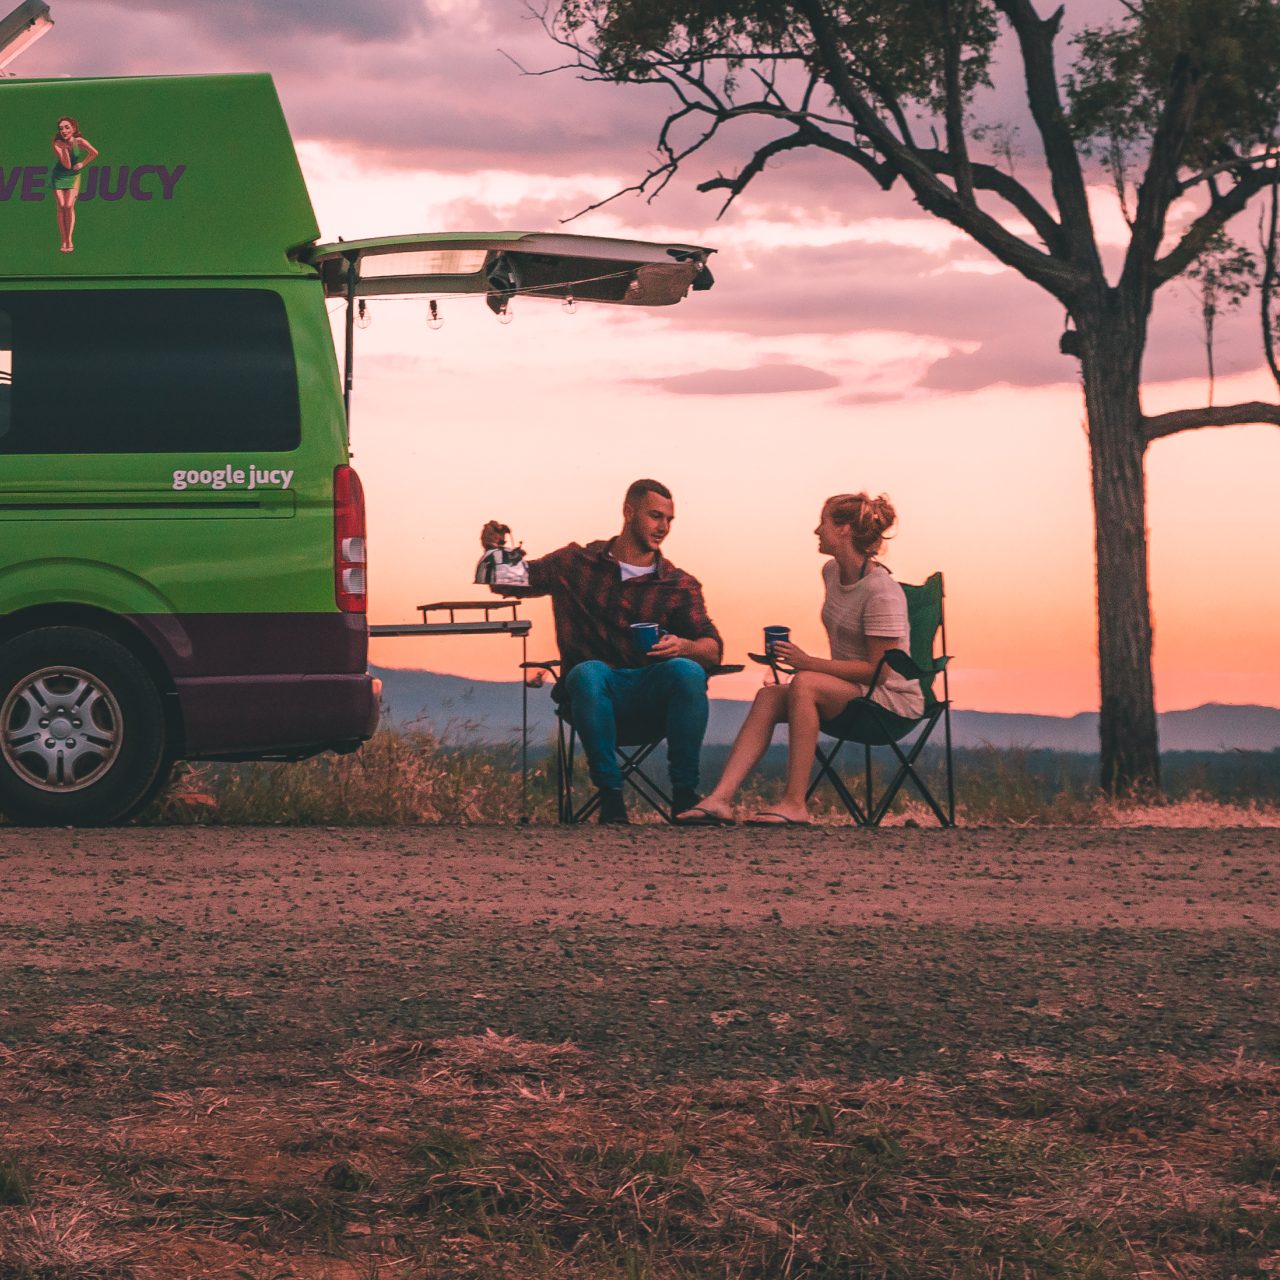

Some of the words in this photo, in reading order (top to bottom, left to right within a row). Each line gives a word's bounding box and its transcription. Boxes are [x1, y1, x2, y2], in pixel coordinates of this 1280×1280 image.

[79, 164, 187, 201] JUCY
[172, 464, 245, 490] google
[249, 464, 294, 490] jucy
